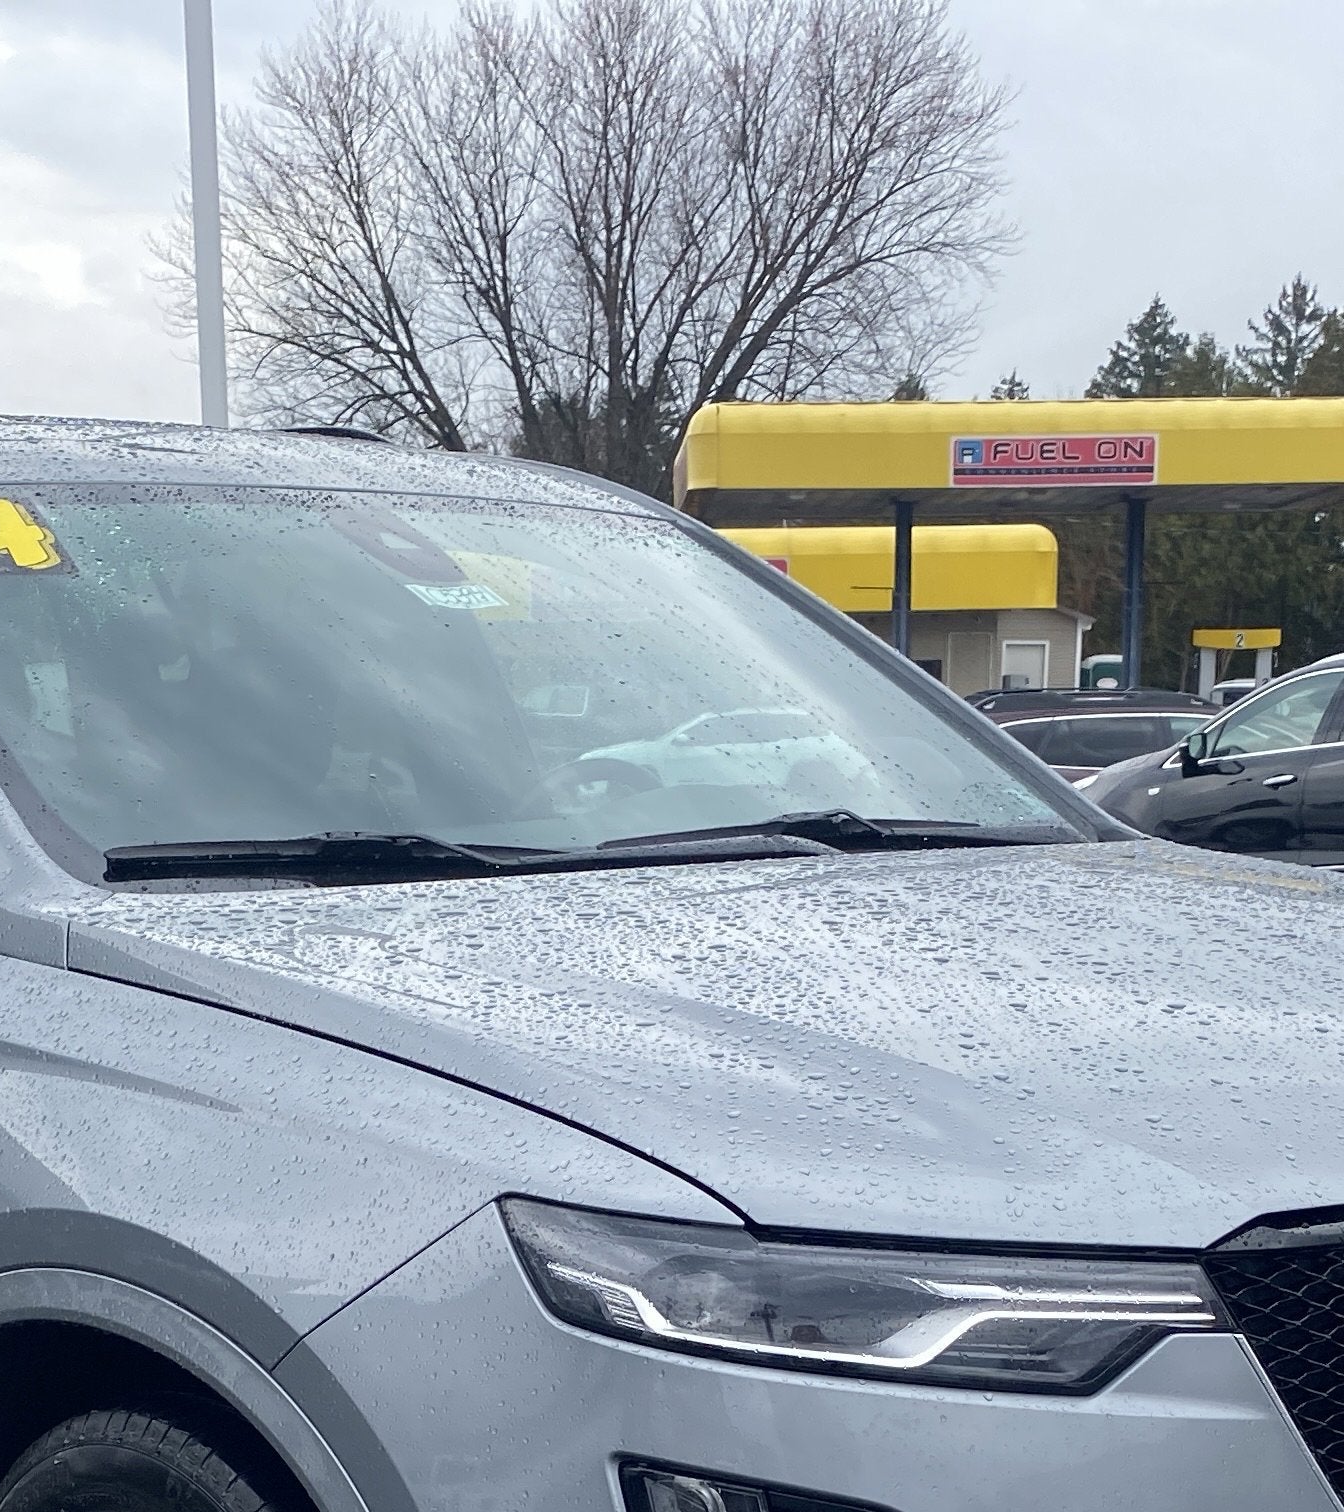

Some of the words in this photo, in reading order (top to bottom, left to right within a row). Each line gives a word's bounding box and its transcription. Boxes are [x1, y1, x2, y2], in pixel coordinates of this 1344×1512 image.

[992, 442, 1080, 461] FUEL
[1097, 440, 1144, 460] ON
[1236, 632, 1244, 648] 2
